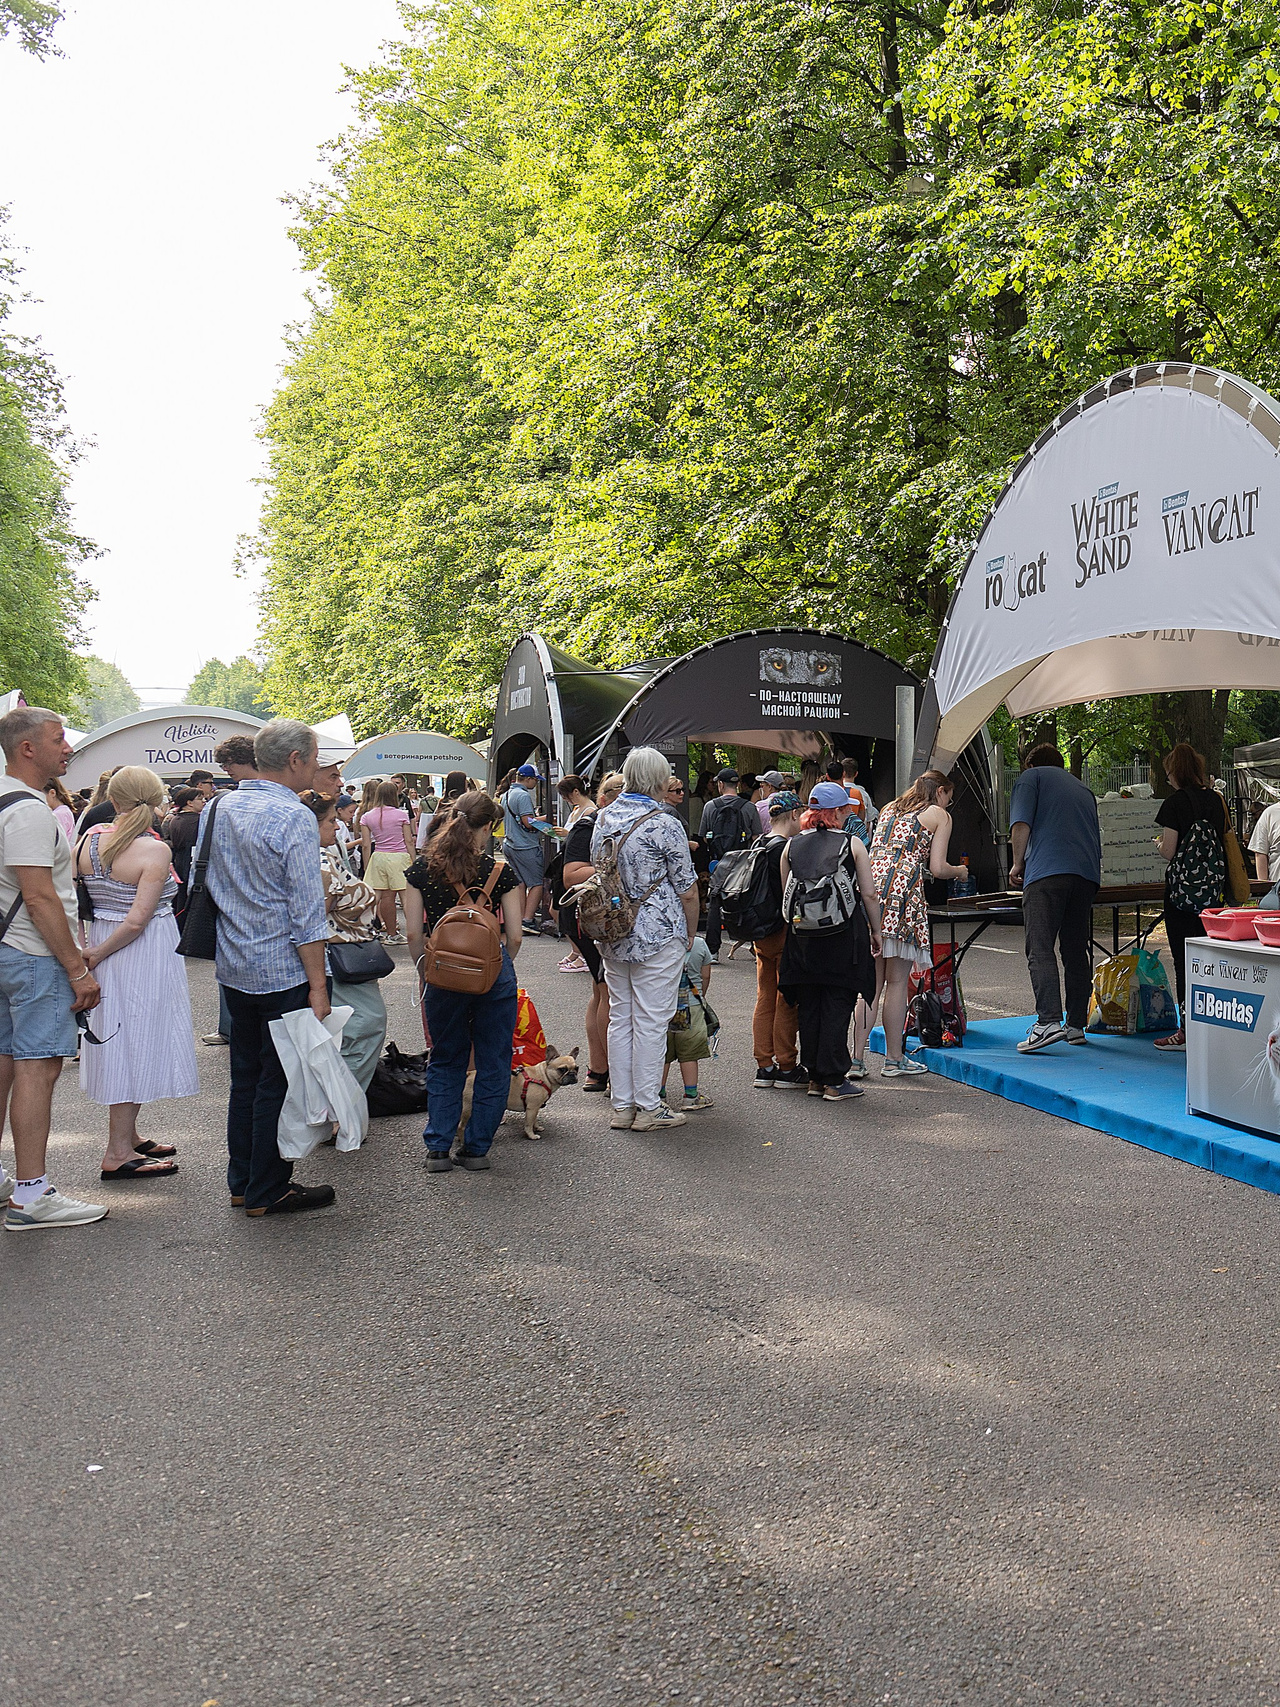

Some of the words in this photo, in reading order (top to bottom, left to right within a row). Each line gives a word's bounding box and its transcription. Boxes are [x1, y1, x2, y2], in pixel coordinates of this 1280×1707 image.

[1071, 491, 1139, 547] WHITE
[1075, 535, 1132, 588] SAND
[760, 690, 842, 705] ПО-НАСТОЯЩЕМУ
[762, 703, 801, 717] МЯСНОЙ
[804, 706, 840, 719] РАЦИОН
[164, 724, 219, 743] Holistic
[1206, 992, 1254, 1028] Bentaş
[18, 1179, 43, 1187] FILA
